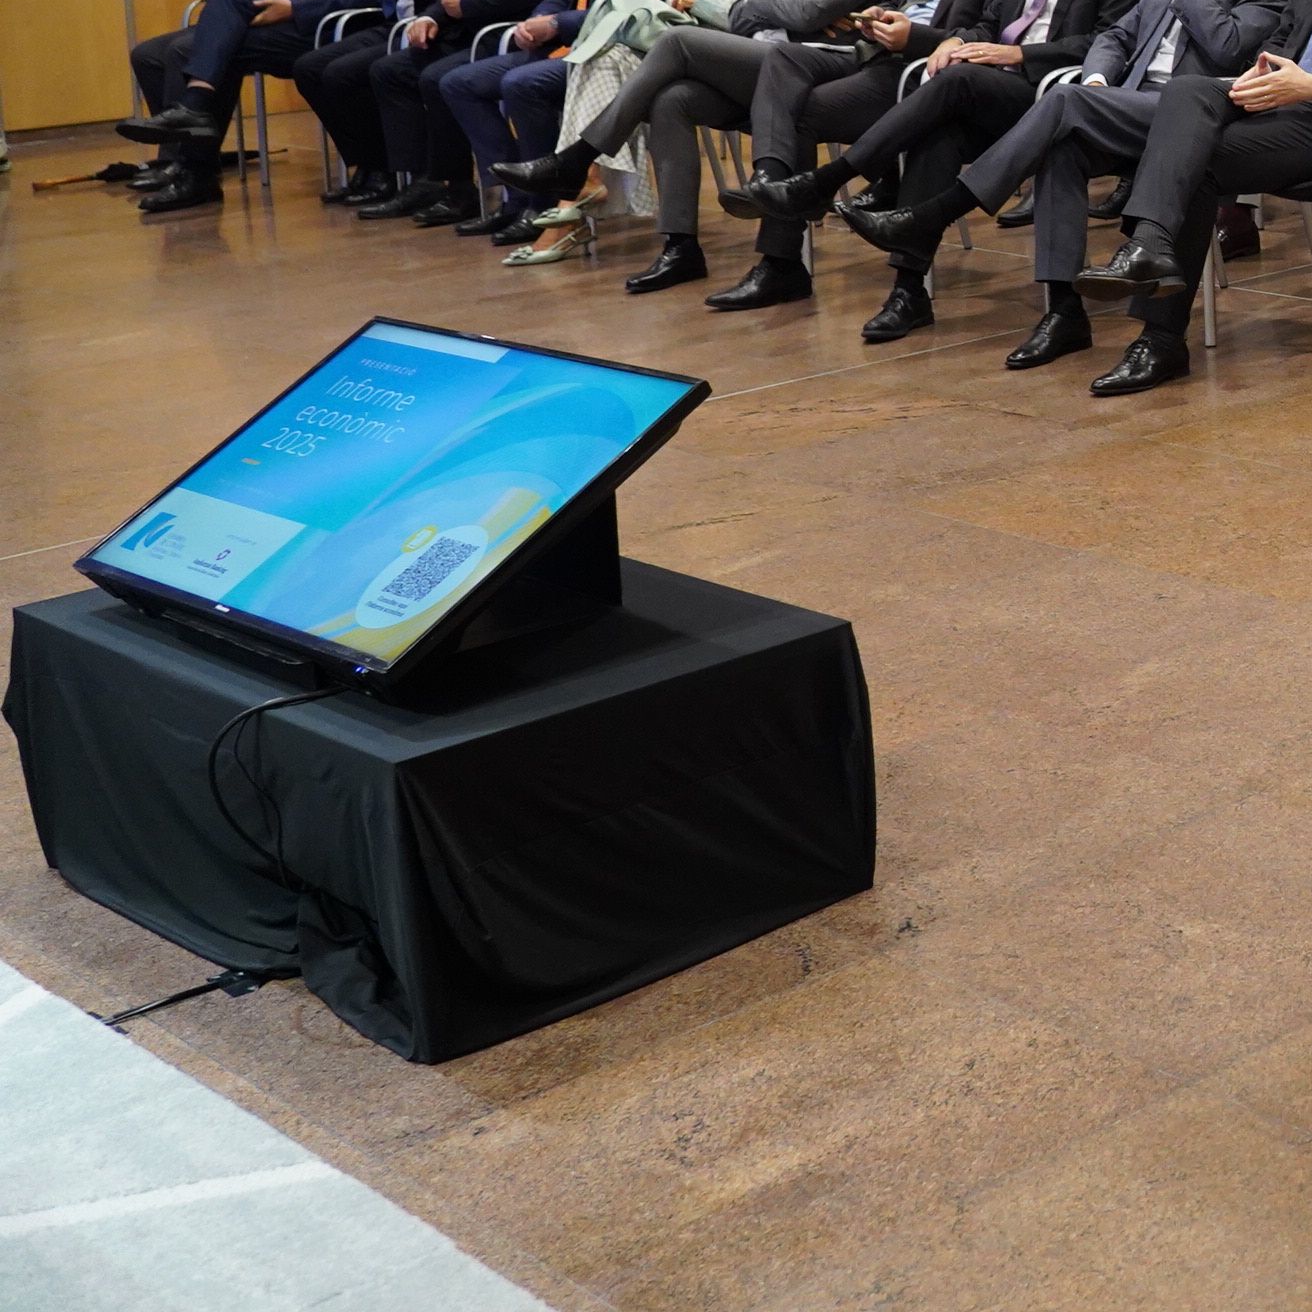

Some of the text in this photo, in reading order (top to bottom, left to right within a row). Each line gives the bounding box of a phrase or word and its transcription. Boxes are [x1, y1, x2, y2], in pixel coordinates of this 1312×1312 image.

[326, 375, 416, 411] Informe
[261, 427, 327, 457] 2025
[296, 405, 406, 444] econòmic
